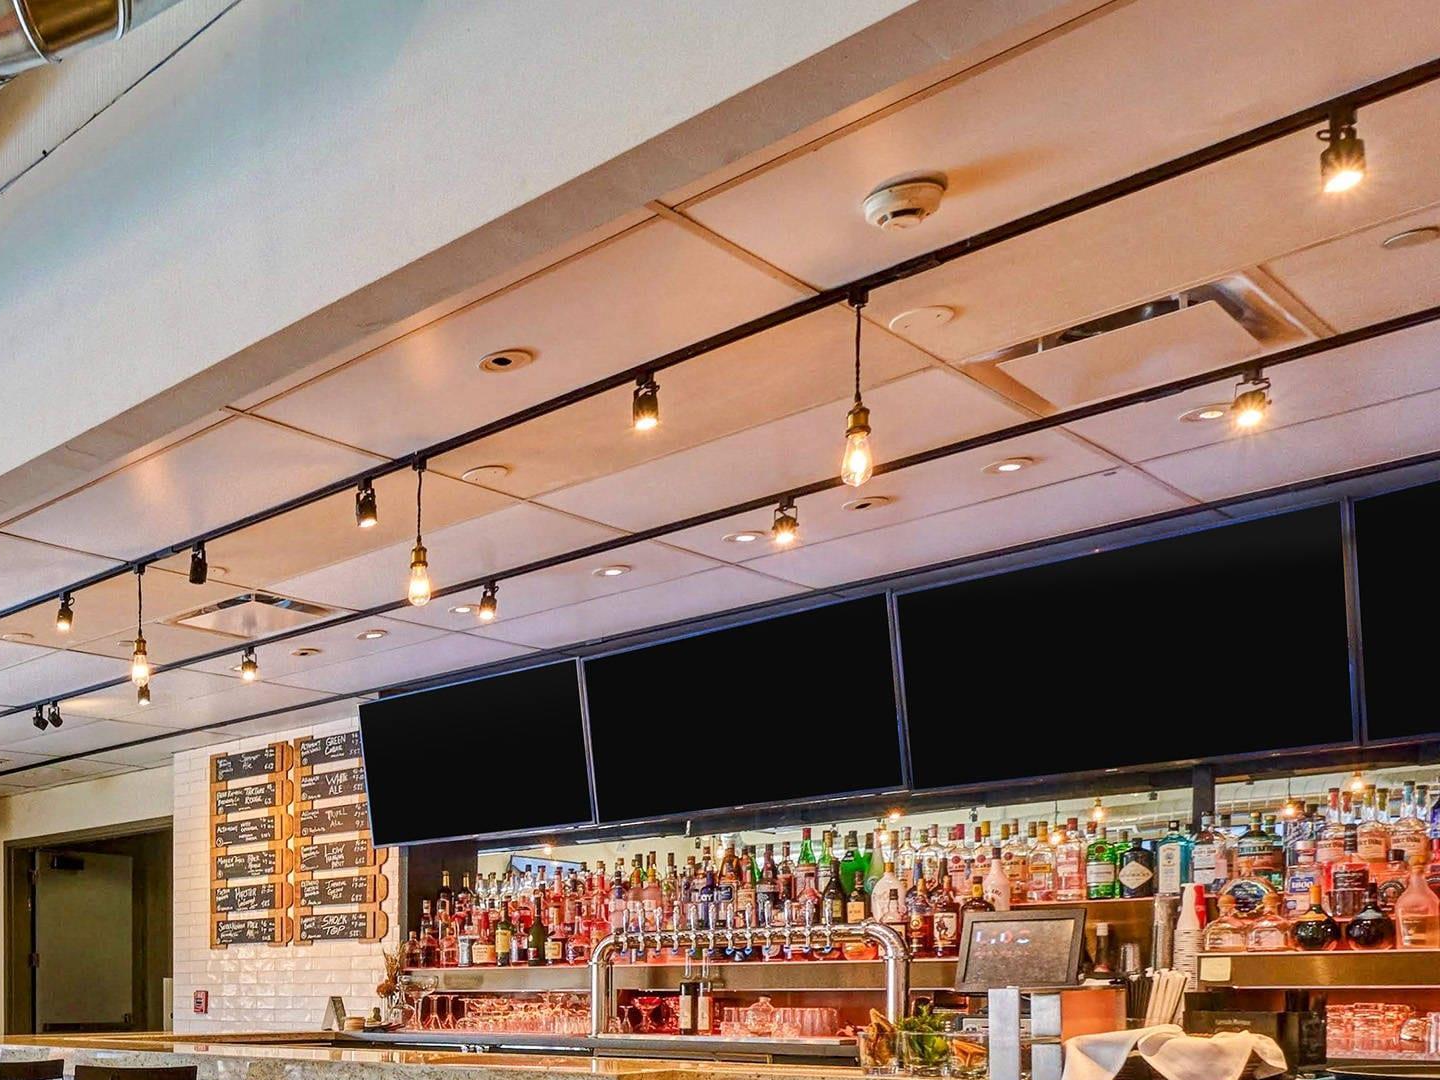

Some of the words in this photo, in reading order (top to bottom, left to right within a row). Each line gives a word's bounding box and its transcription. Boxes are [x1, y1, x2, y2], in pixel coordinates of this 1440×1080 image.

[325, 734, 346, 747] GREEN
[329, 784, 343, 795] ALE
[321, 914, 348, 927] SHOCK
[322, 925, 345, 936] TOP
